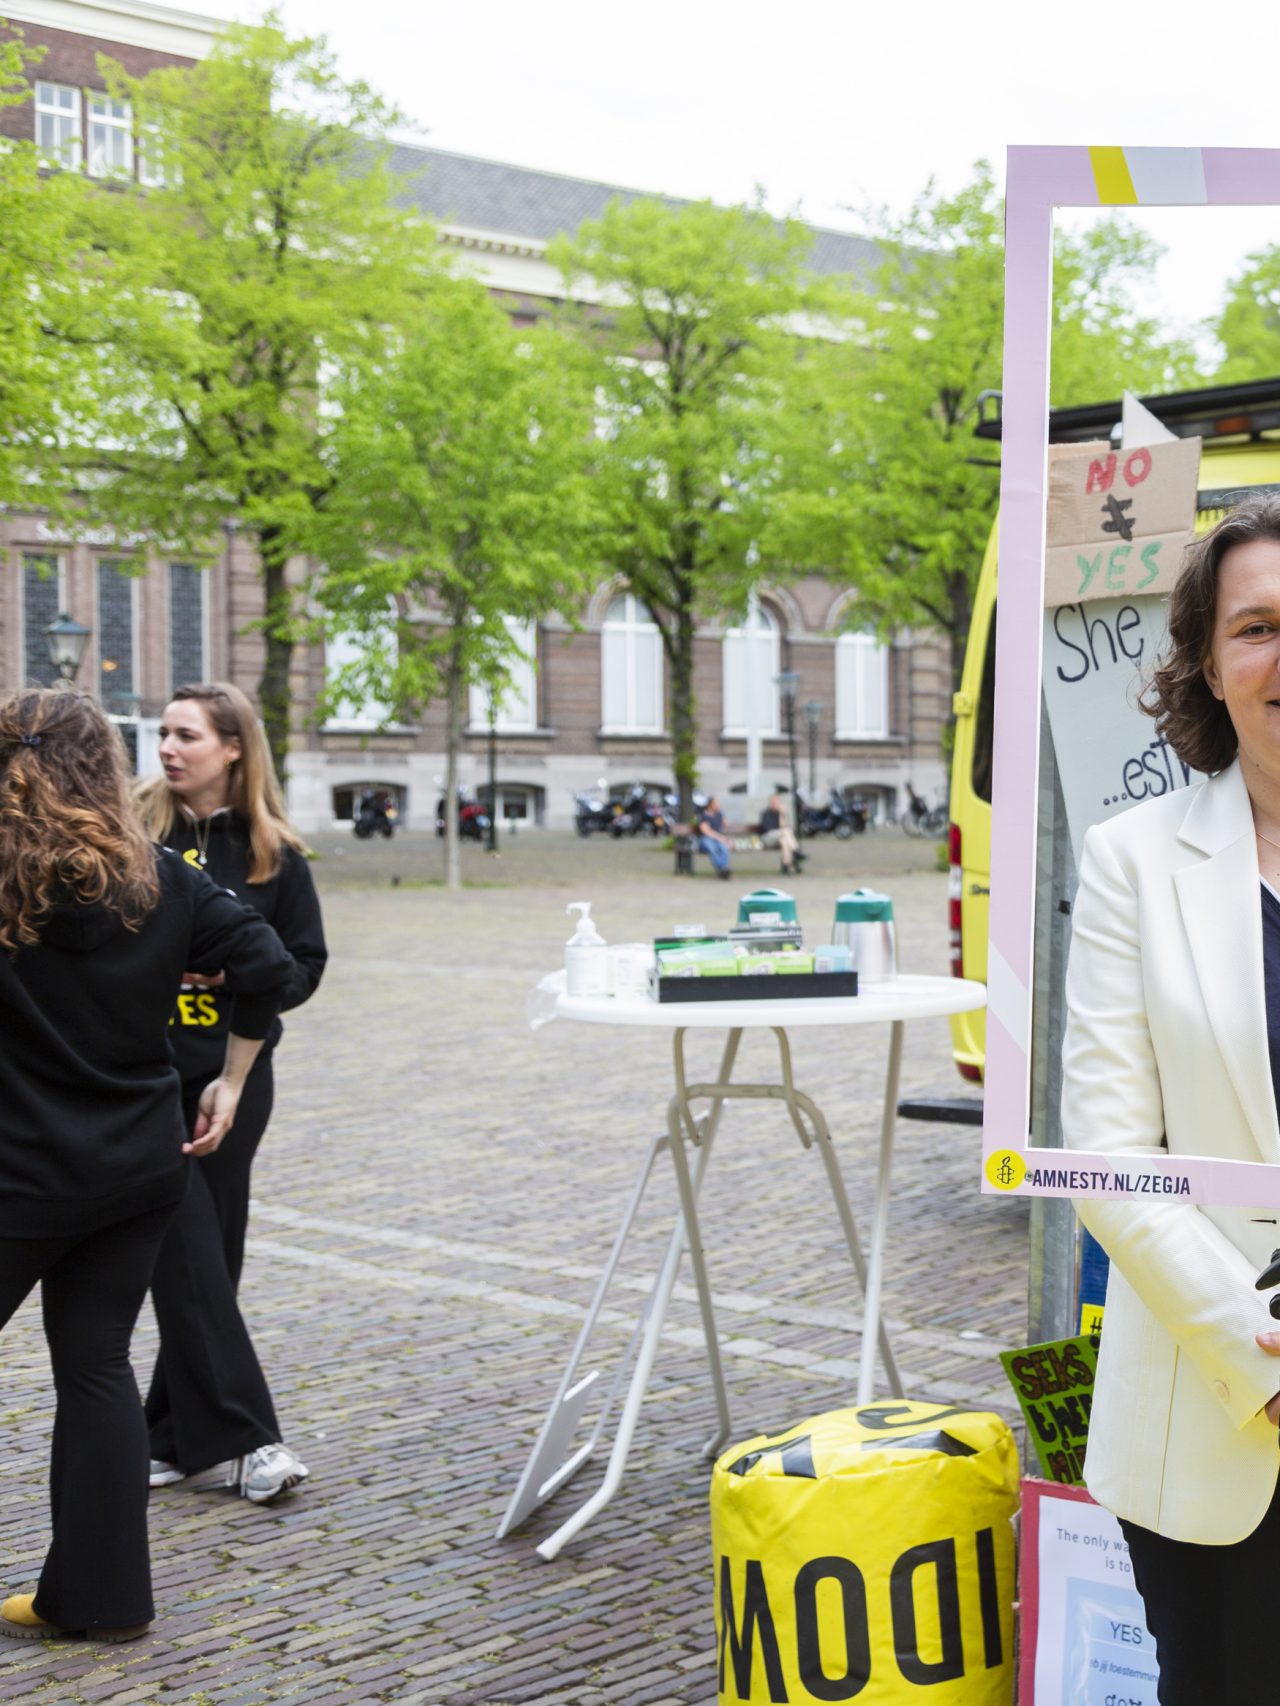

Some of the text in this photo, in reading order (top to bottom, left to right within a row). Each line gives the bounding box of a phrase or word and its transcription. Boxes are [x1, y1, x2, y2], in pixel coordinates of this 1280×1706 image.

[1086, 448, 1152, 494] NO
[1076, 541, 1163, 595] YES
[168, 993, 220, 1027] ES
[1032, 1169, 1191, 1195] AMNESTY.NL/ZEGJA
[1057, 1528, 1130, 1552] The only wa
[1106, 1556, 1131, 1573] is to
[1110, 1621, 1143, 1645] YES
